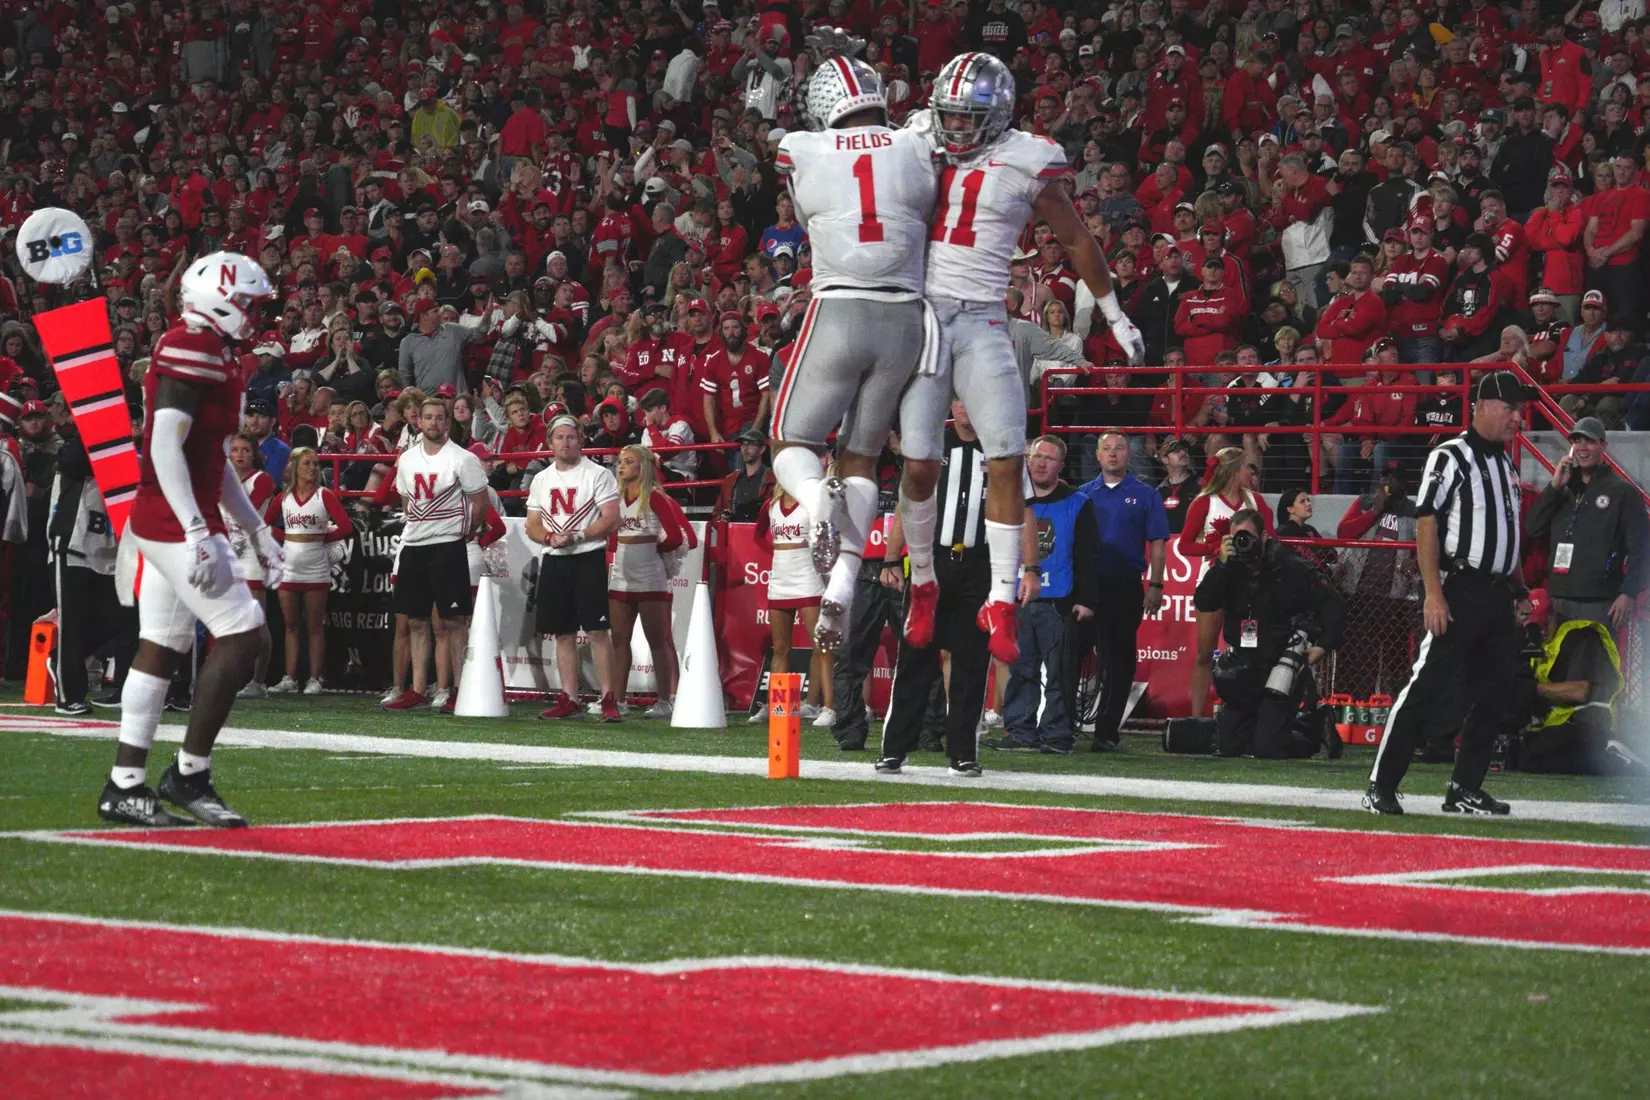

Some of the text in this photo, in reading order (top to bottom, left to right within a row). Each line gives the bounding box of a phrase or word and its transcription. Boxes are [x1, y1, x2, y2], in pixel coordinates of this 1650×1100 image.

[836, 133, 892, 150] FIELDS
[853, 154, 883, 243] 1
[931, 165, 985, 248] 11
[220, 264, 236, 286] N
[661, 348, 675, 362] N
[730, 379, 743, 408] 1
[414, 472, 438, 501] N
[550, 487, 578, 516] N
[285, 512, 319, 529] Huskers
[770, 516, 804, 541] Huskers
[332, 612, 352, 628] BIG
[357, 611, 389, 629] RED!
[772, 689, 786, 703] N
[1365, 729, 1376, 743] G
